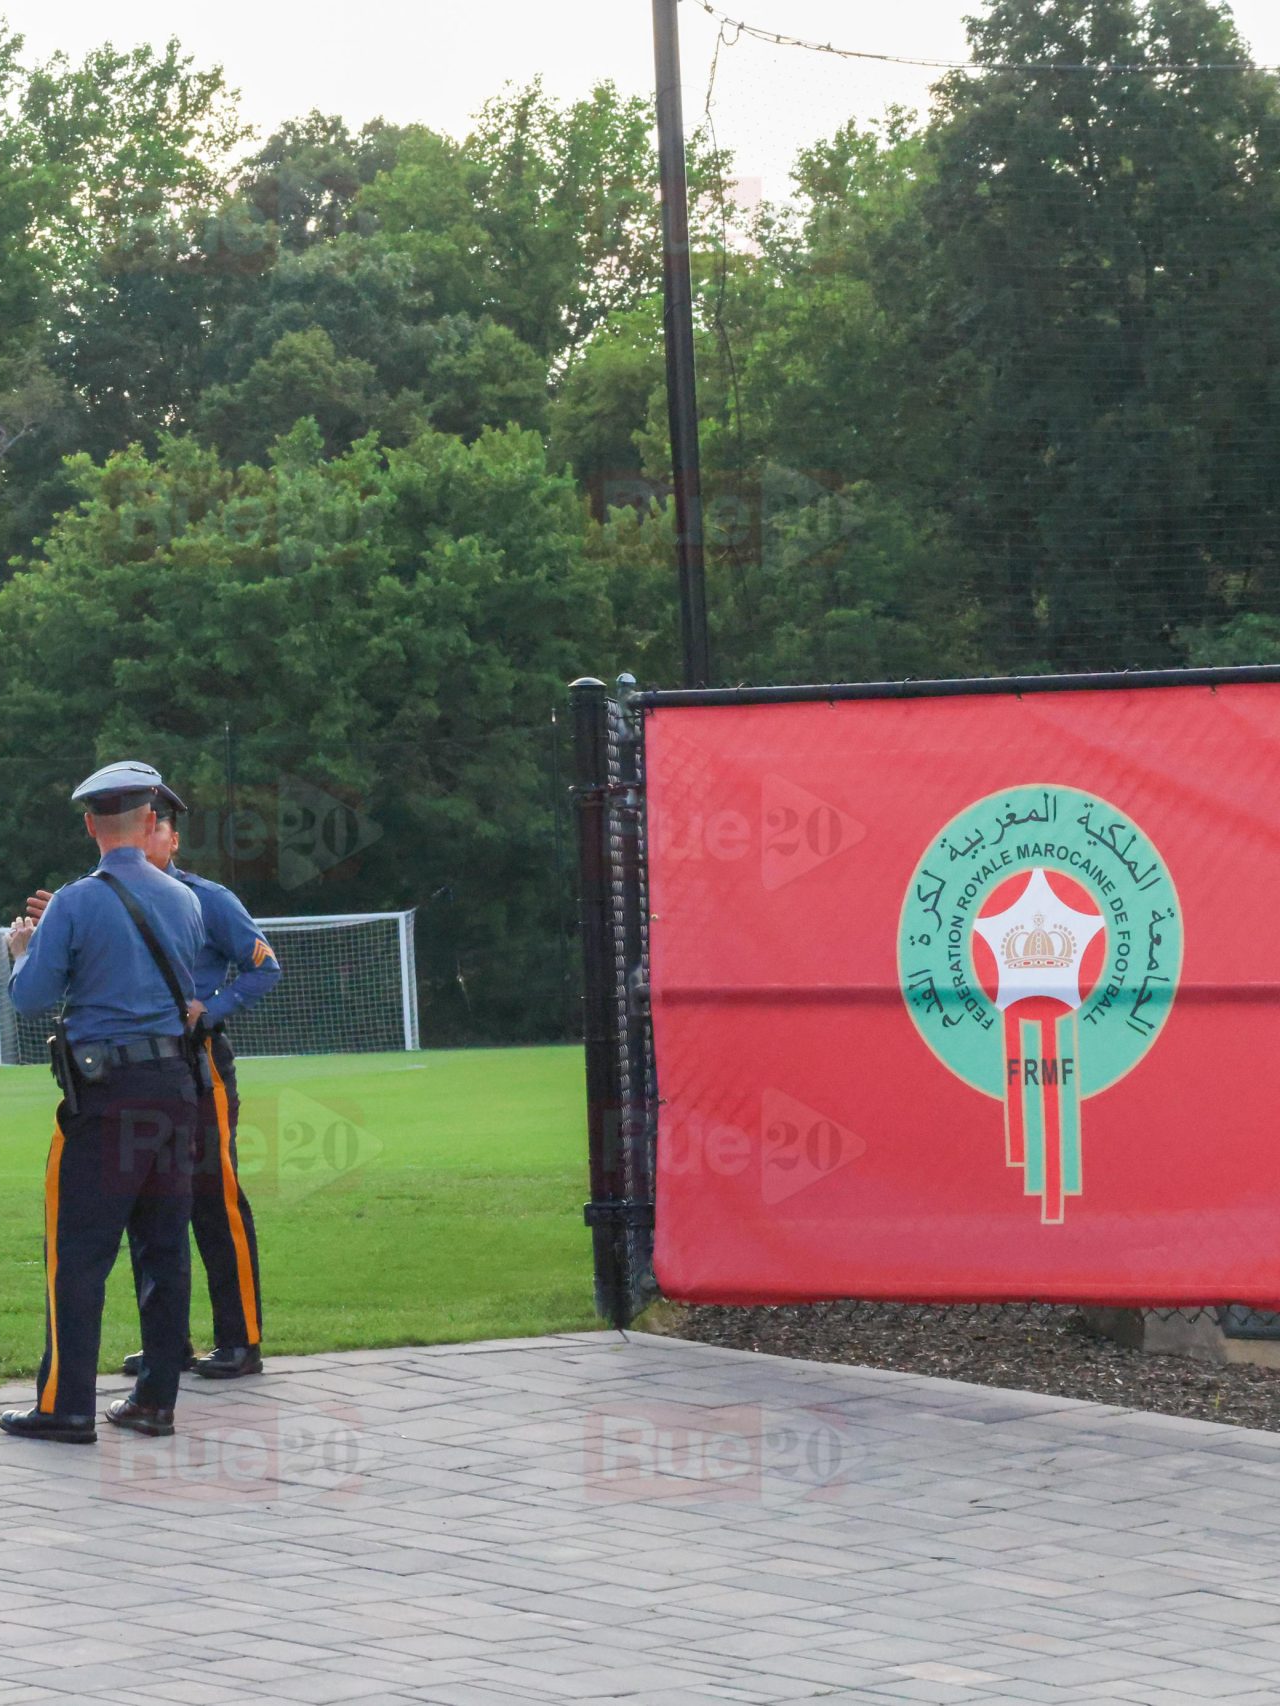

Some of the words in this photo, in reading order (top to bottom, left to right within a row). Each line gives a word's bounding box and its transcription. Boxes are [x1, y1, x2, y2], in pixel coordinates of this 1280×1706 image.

[940, 792, 1057, 862] المغربية
[1077, 803, 1161, 891] الملكية
[956, 850, 1013, 910] ROYALE
[1016, 842, 1117, 896] MAROCAINE
[909, 869, 946, 946] لكرة
[1109, 897, 1128, 925] DE
[1083, 930, 1131, 1025] FOOTBALL
[1125, 907, 1174, 1036] الجامعة
[1007, 1058, 1075, 1085] FRMF
